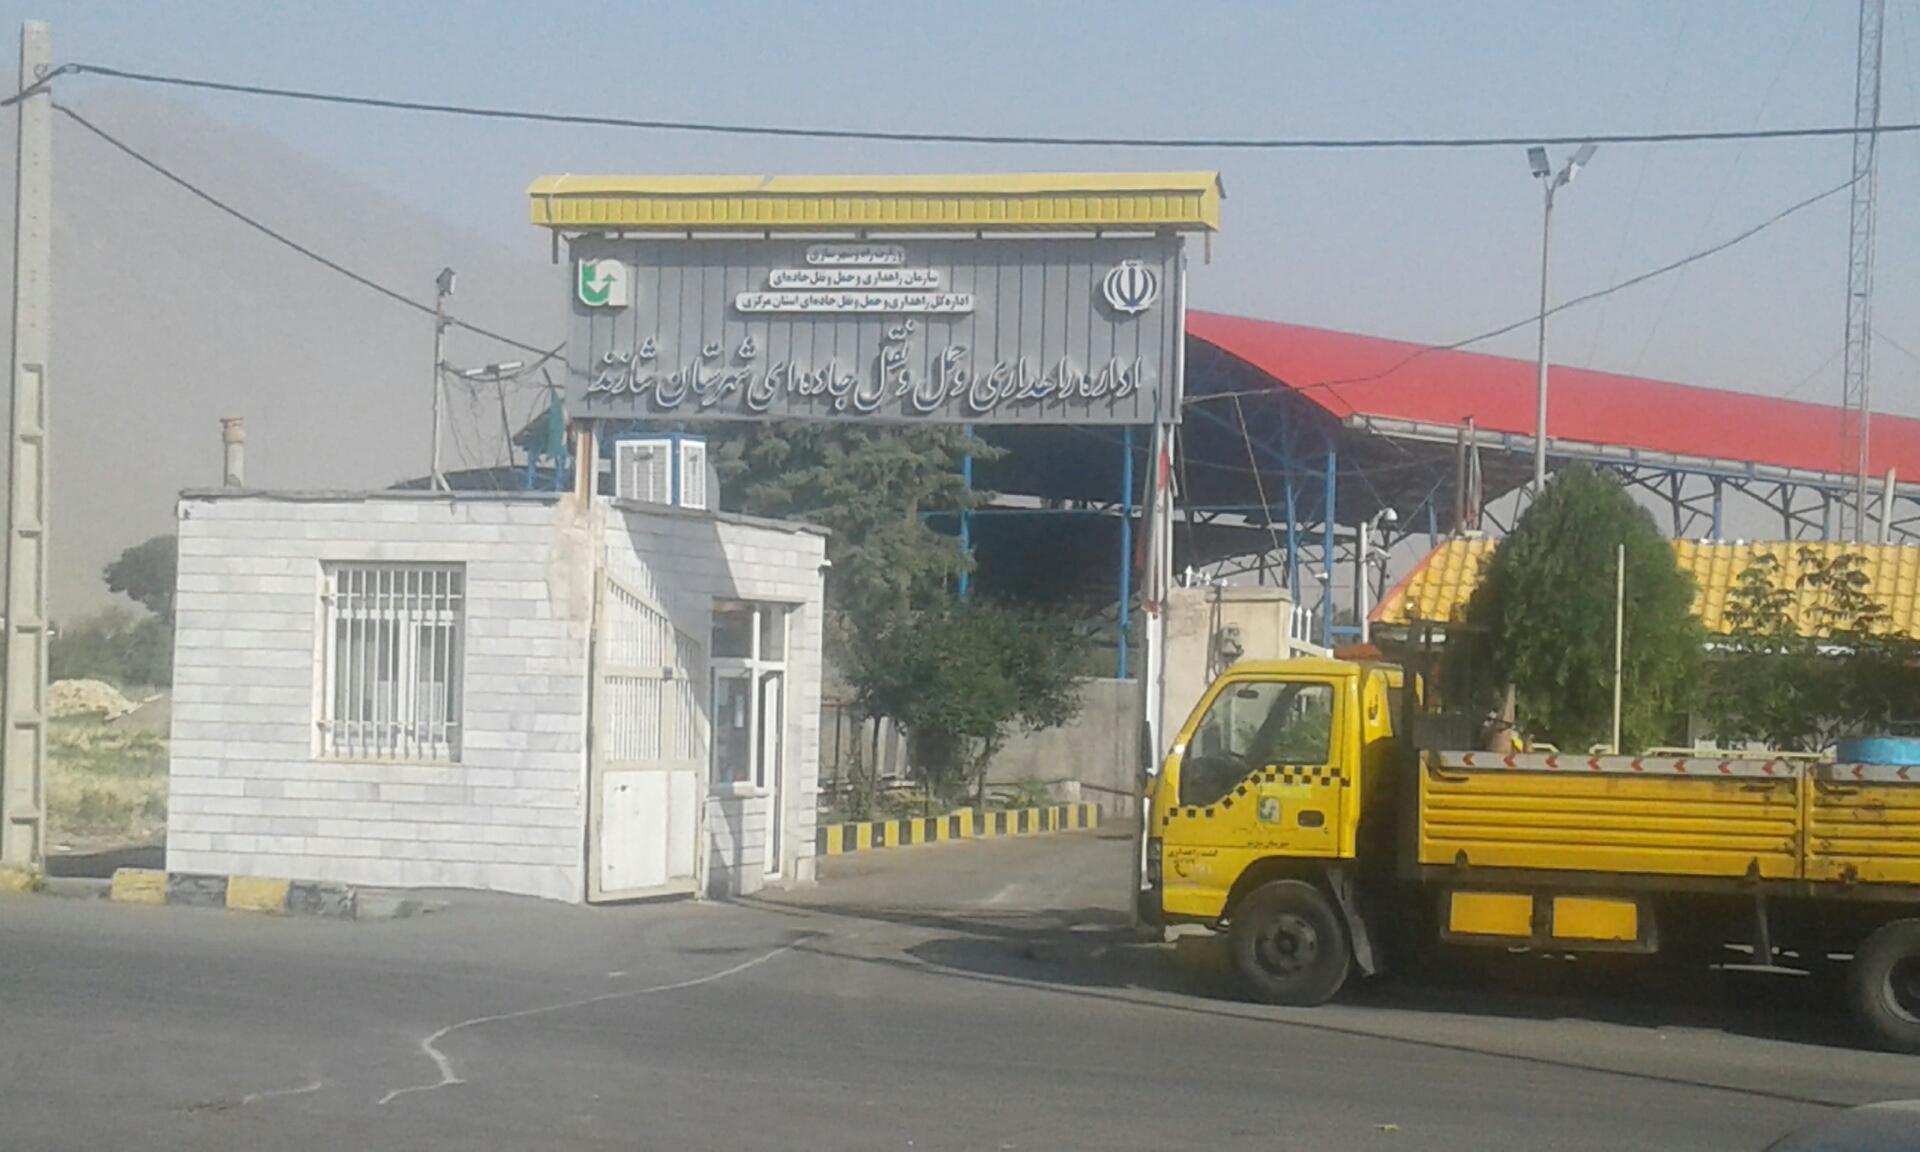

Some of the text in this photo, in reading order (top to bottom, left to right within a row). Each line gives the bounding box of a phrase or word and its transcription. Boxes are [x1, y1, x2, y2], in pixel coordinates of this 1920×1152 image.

[862, 271, 902, 286] راهداری
[904, 271, 938, 286] سازمان
[888, 294, 930, 309] راهداری
[945, 295, 970, 309] اداره
[587, 335, 658, 395] شازند
[655, 335, 758, 408] شهرستان
[1079, 355, 1143, 398] اداره
[968, 355, 1075, 412] راهداری
